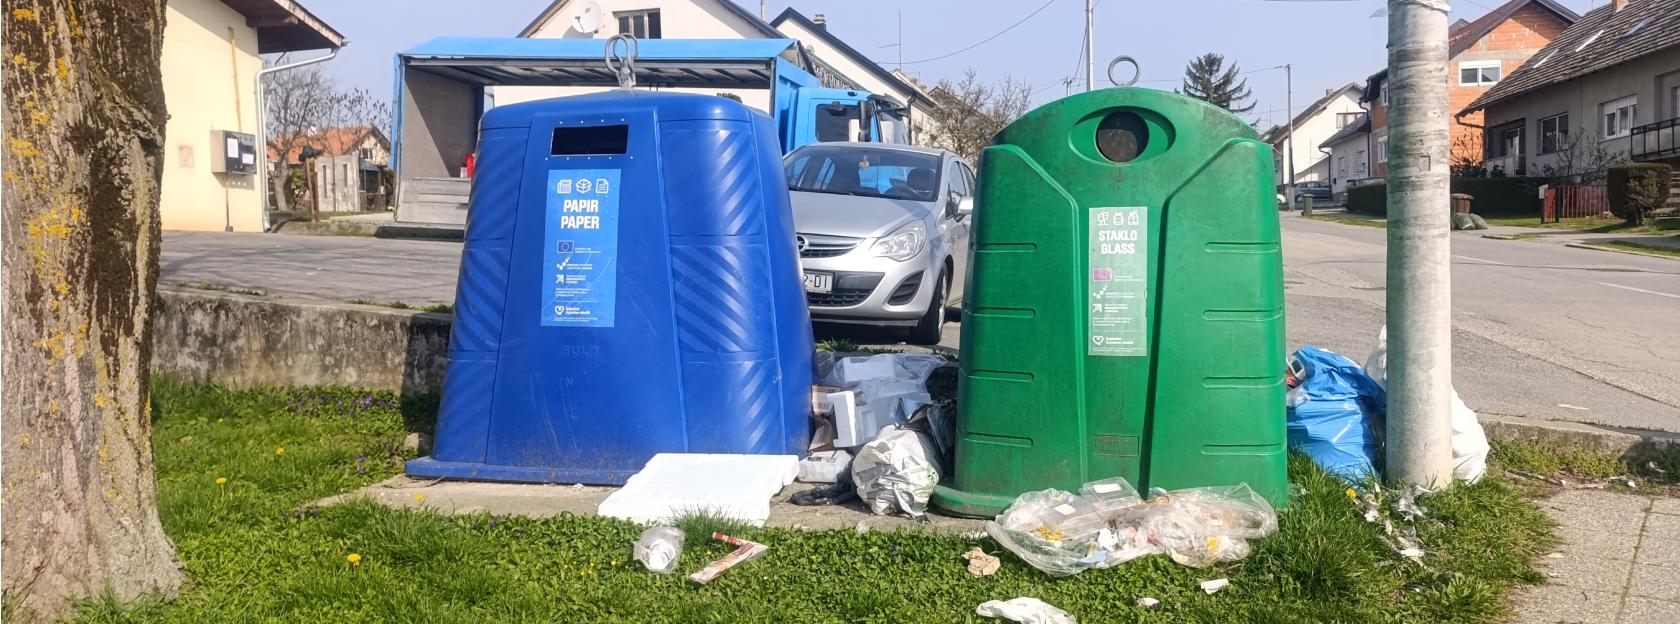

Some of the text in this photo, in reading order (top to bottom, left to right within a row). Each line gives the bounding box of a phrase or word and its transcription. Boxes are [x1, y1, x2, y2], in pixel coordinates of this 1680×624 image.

[563, 199, 599, 213] PAPIR
[560, 215, 600, 230] PAPER
[1098, 230, 1138, 241] STAKLO
[1101, 243, 1136, 255] GLASS
